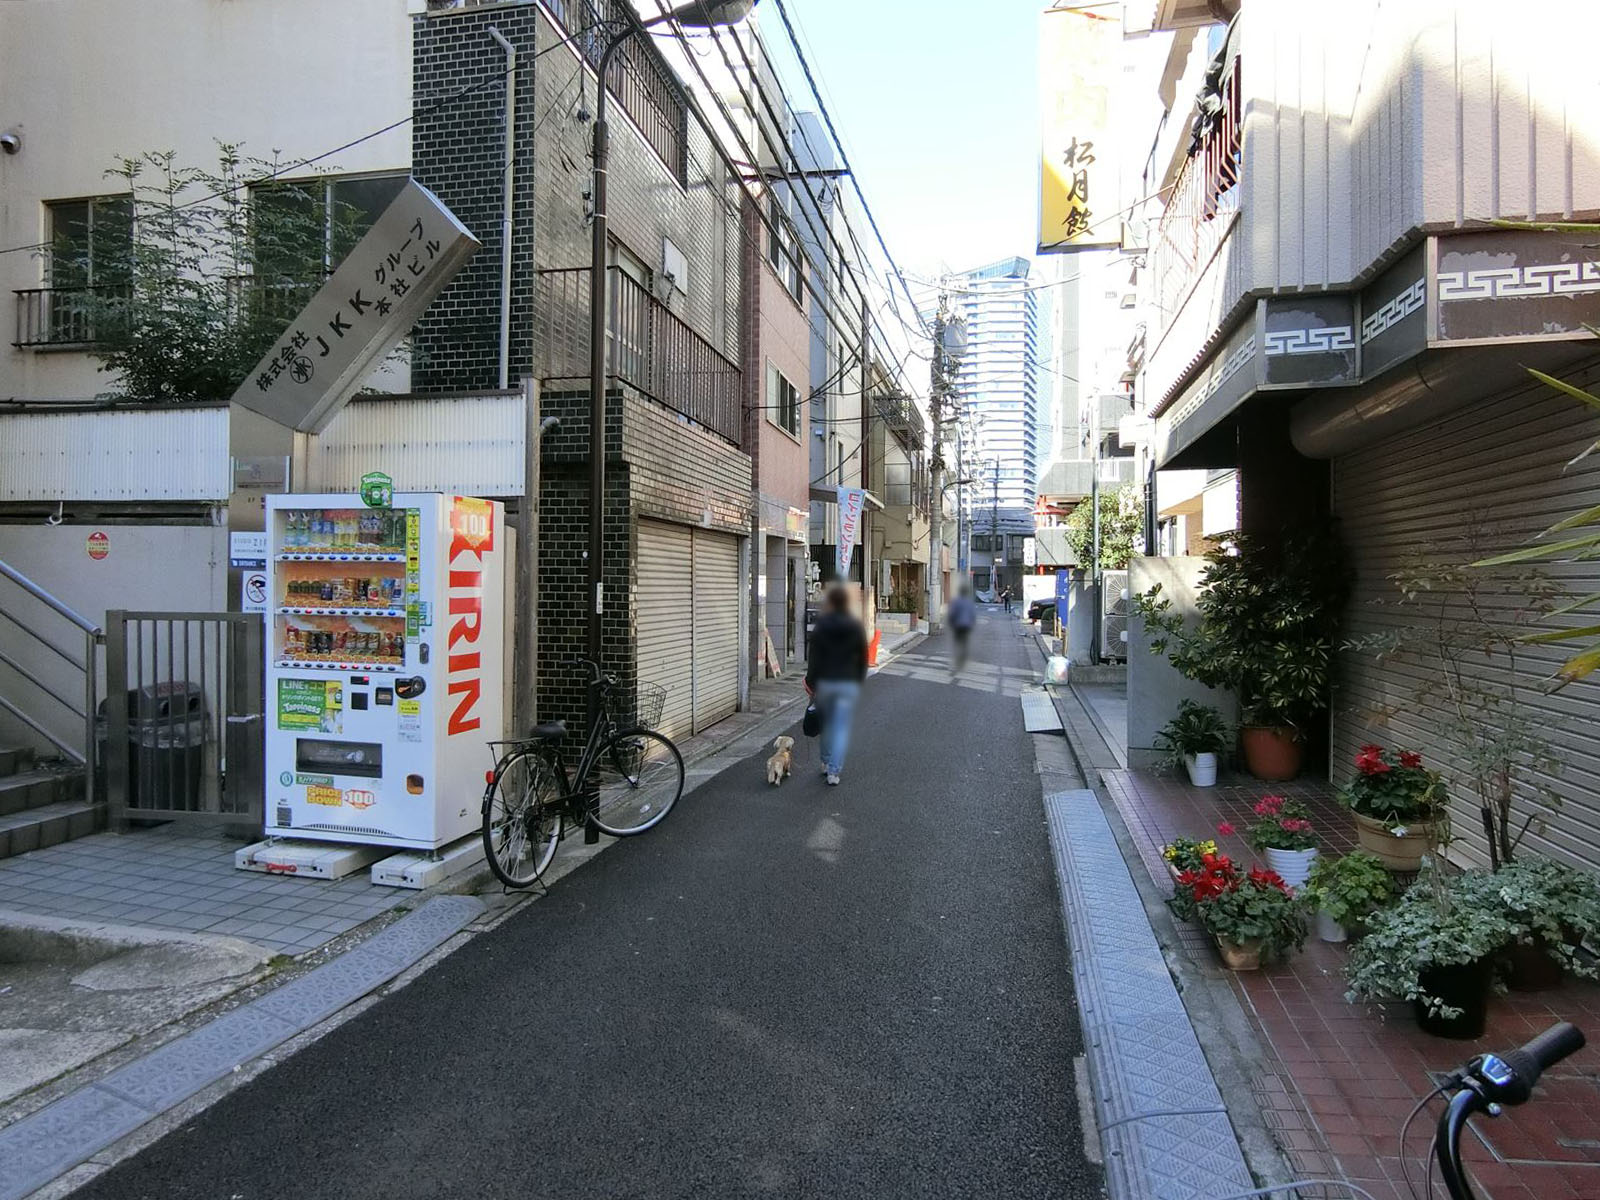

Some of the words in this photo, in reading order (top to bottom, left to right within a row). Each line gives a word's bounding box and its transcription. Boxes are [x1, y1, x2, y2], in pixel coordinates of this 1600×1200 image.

[314, 288, 373, 357] JKK
[374, 216, 424, 285] グループ
[373, 239, 441, 318] 本社ビル
[255, 329, 311, 393] 株式会社
[460, 514, 488, 537] 100
